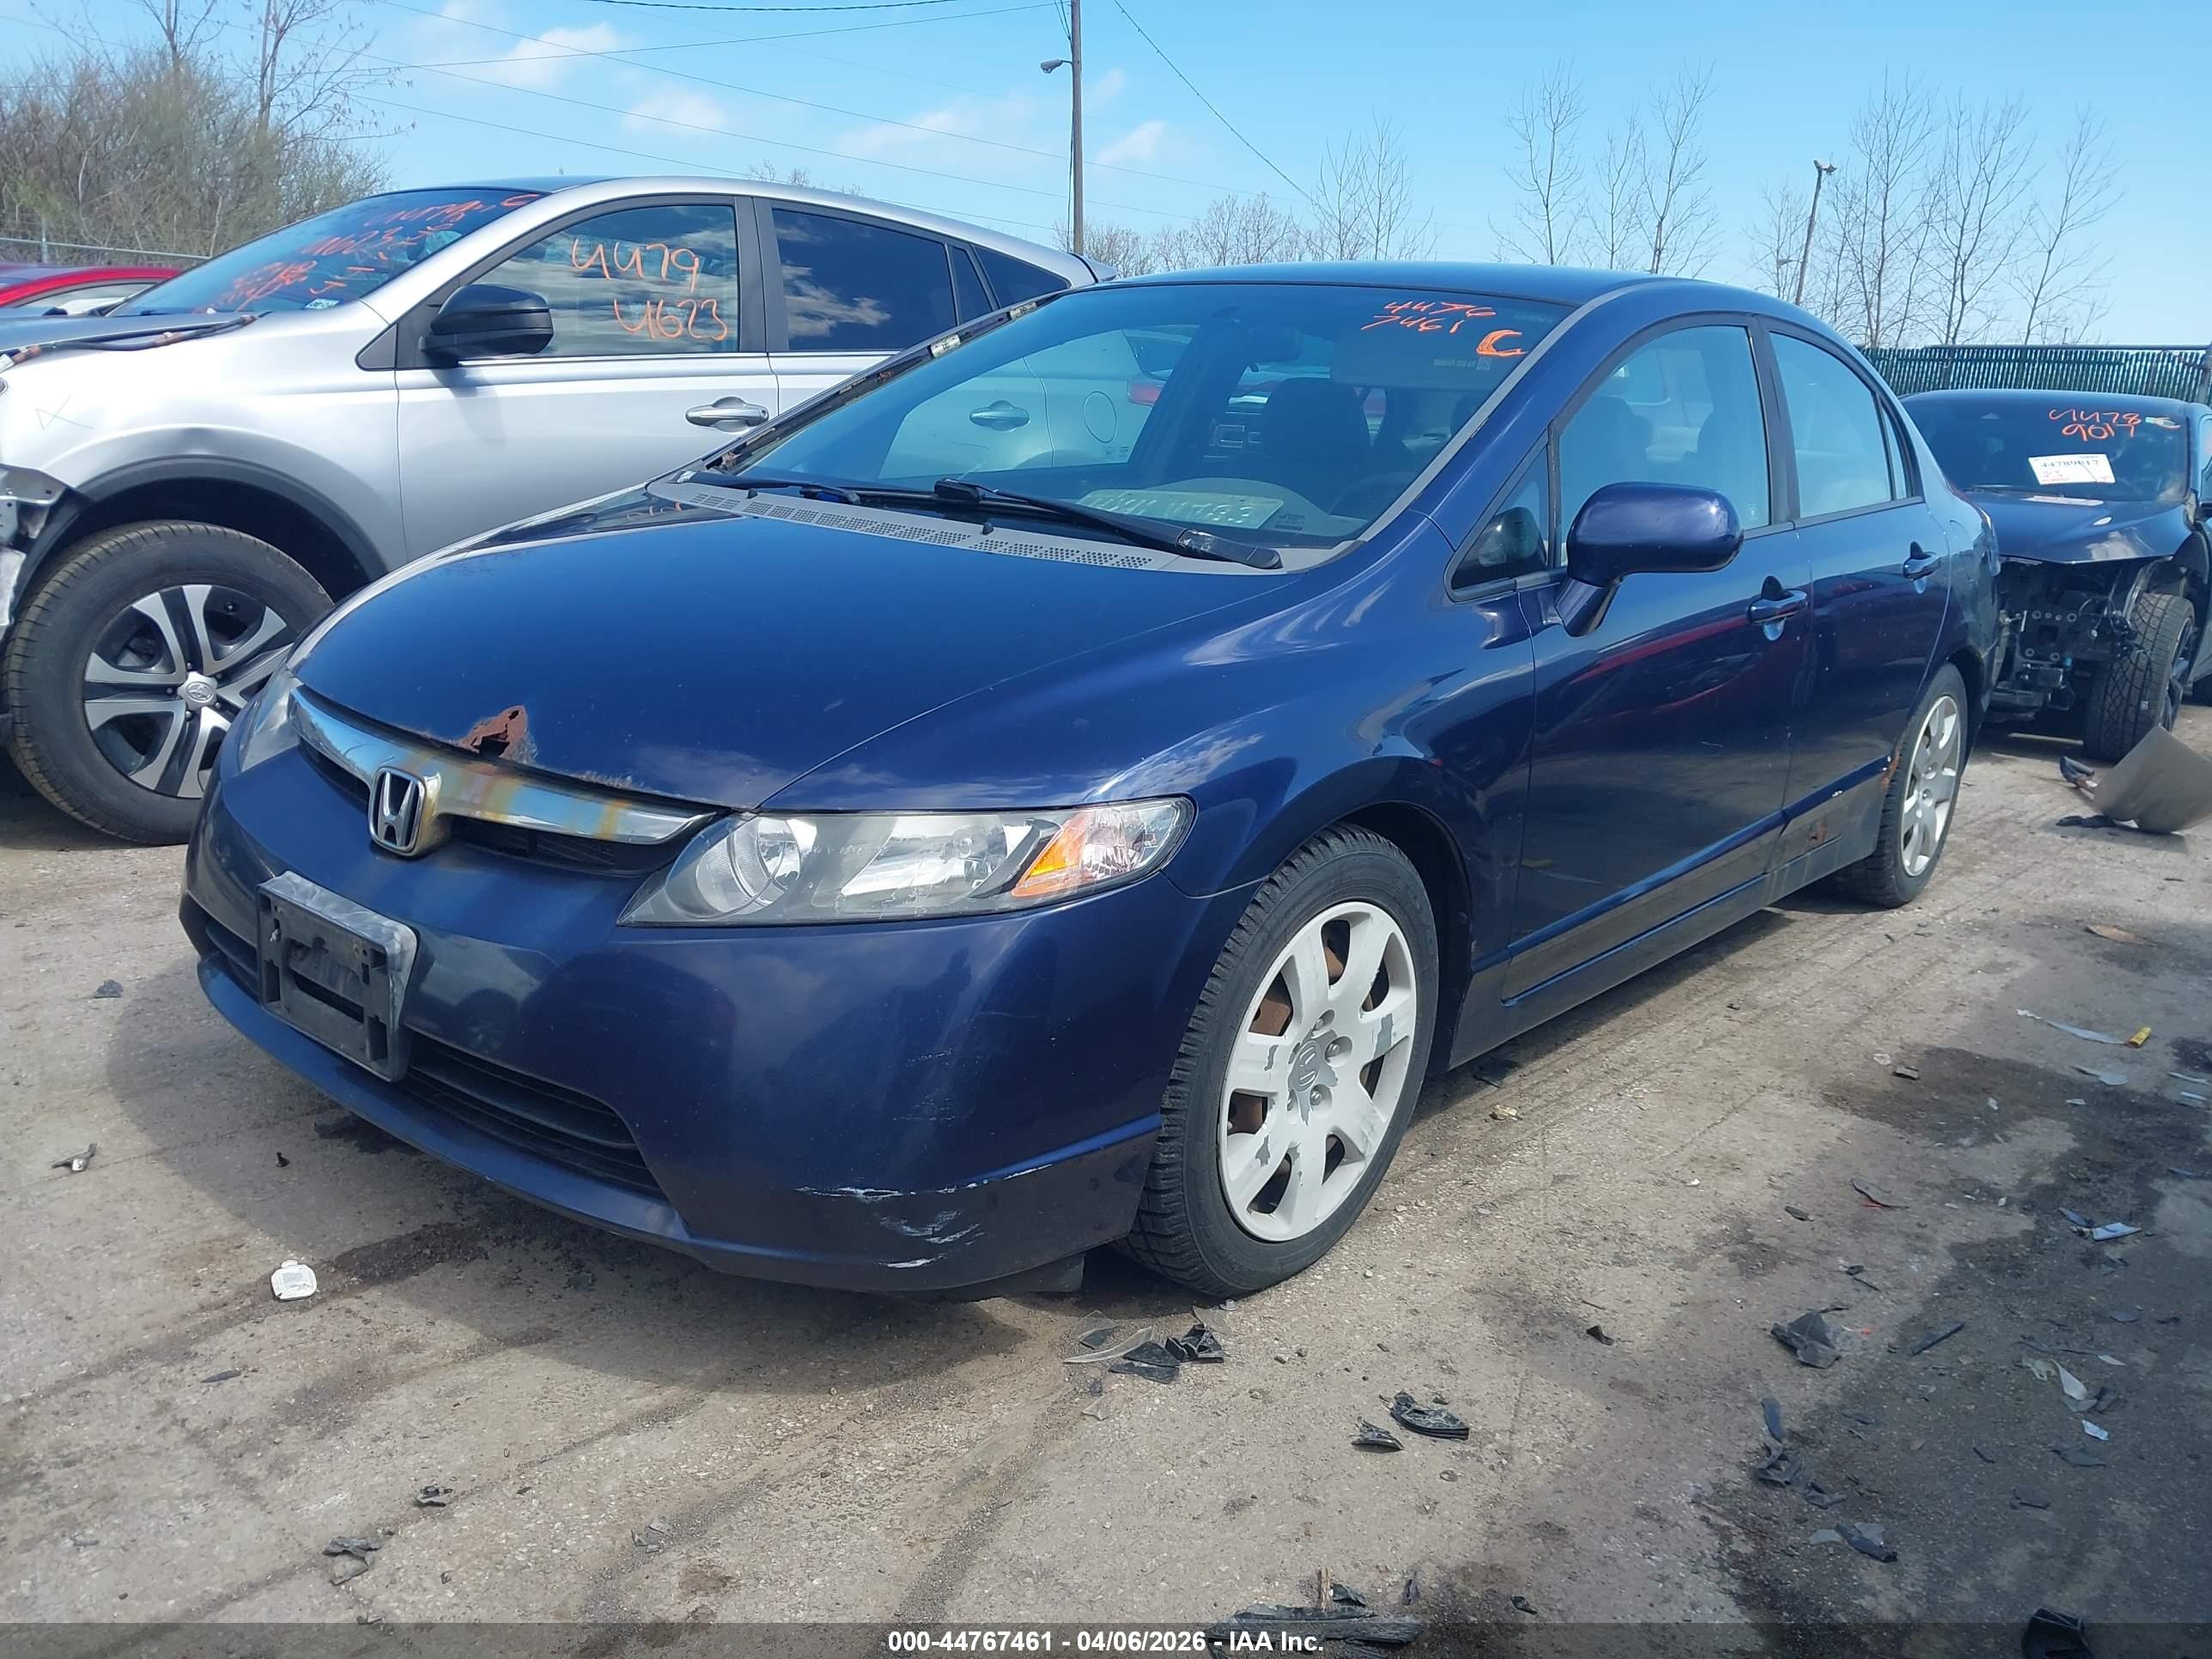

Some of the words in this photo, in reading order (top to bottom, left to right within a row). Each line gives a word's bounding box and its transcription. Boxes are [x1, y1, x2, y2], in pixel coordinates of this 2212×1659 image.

[572, 239, 700, 292] 4479
[1384, 301, 1496, 317] 4476
[614, 299, 729, 341] 4623
[1360, 315, 1466, 333] 7461
[1476, 329, 1528, 357] C
[2049, 409, 2142, 426] 4478
[2062, 422, 2136, 441] 9017
